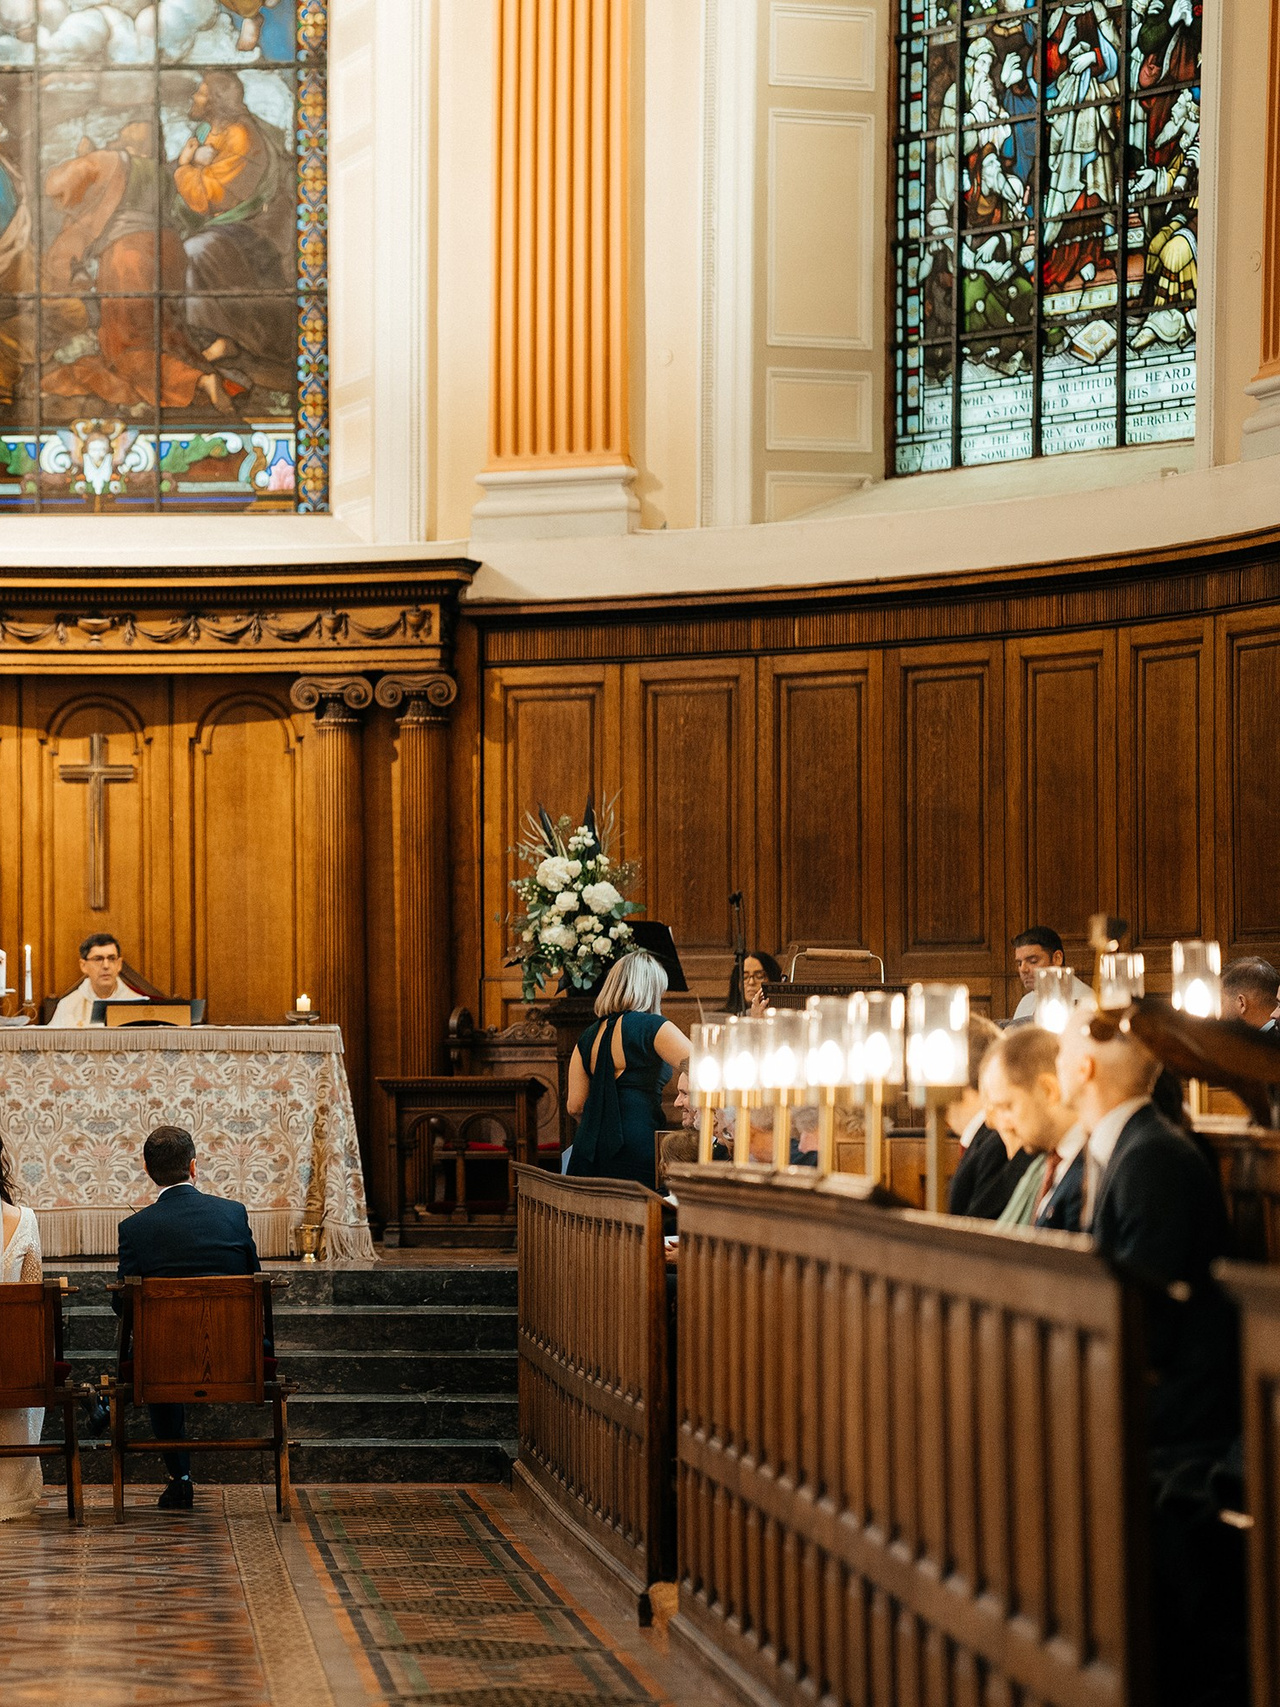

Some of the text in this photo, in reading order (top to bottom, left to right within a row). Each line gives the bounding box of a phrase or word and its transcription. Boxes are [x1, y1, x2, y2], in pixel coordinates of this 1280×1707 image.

[962, 394, 995, 408] WHEN
[1145, 366, 1191, 382] HEARD
[925, 414, 949, 426] WER
[1090, 393, 1104, 405] AT
[1128, 387, 1149, 400] HIS
[1075, 420, 1116, 435] GEORG
[1132, 411, 1191, 427] BERKELEY
[1045, 437, 1086, 453] FELLOW
[1097, 435, 1113, 446] OF
